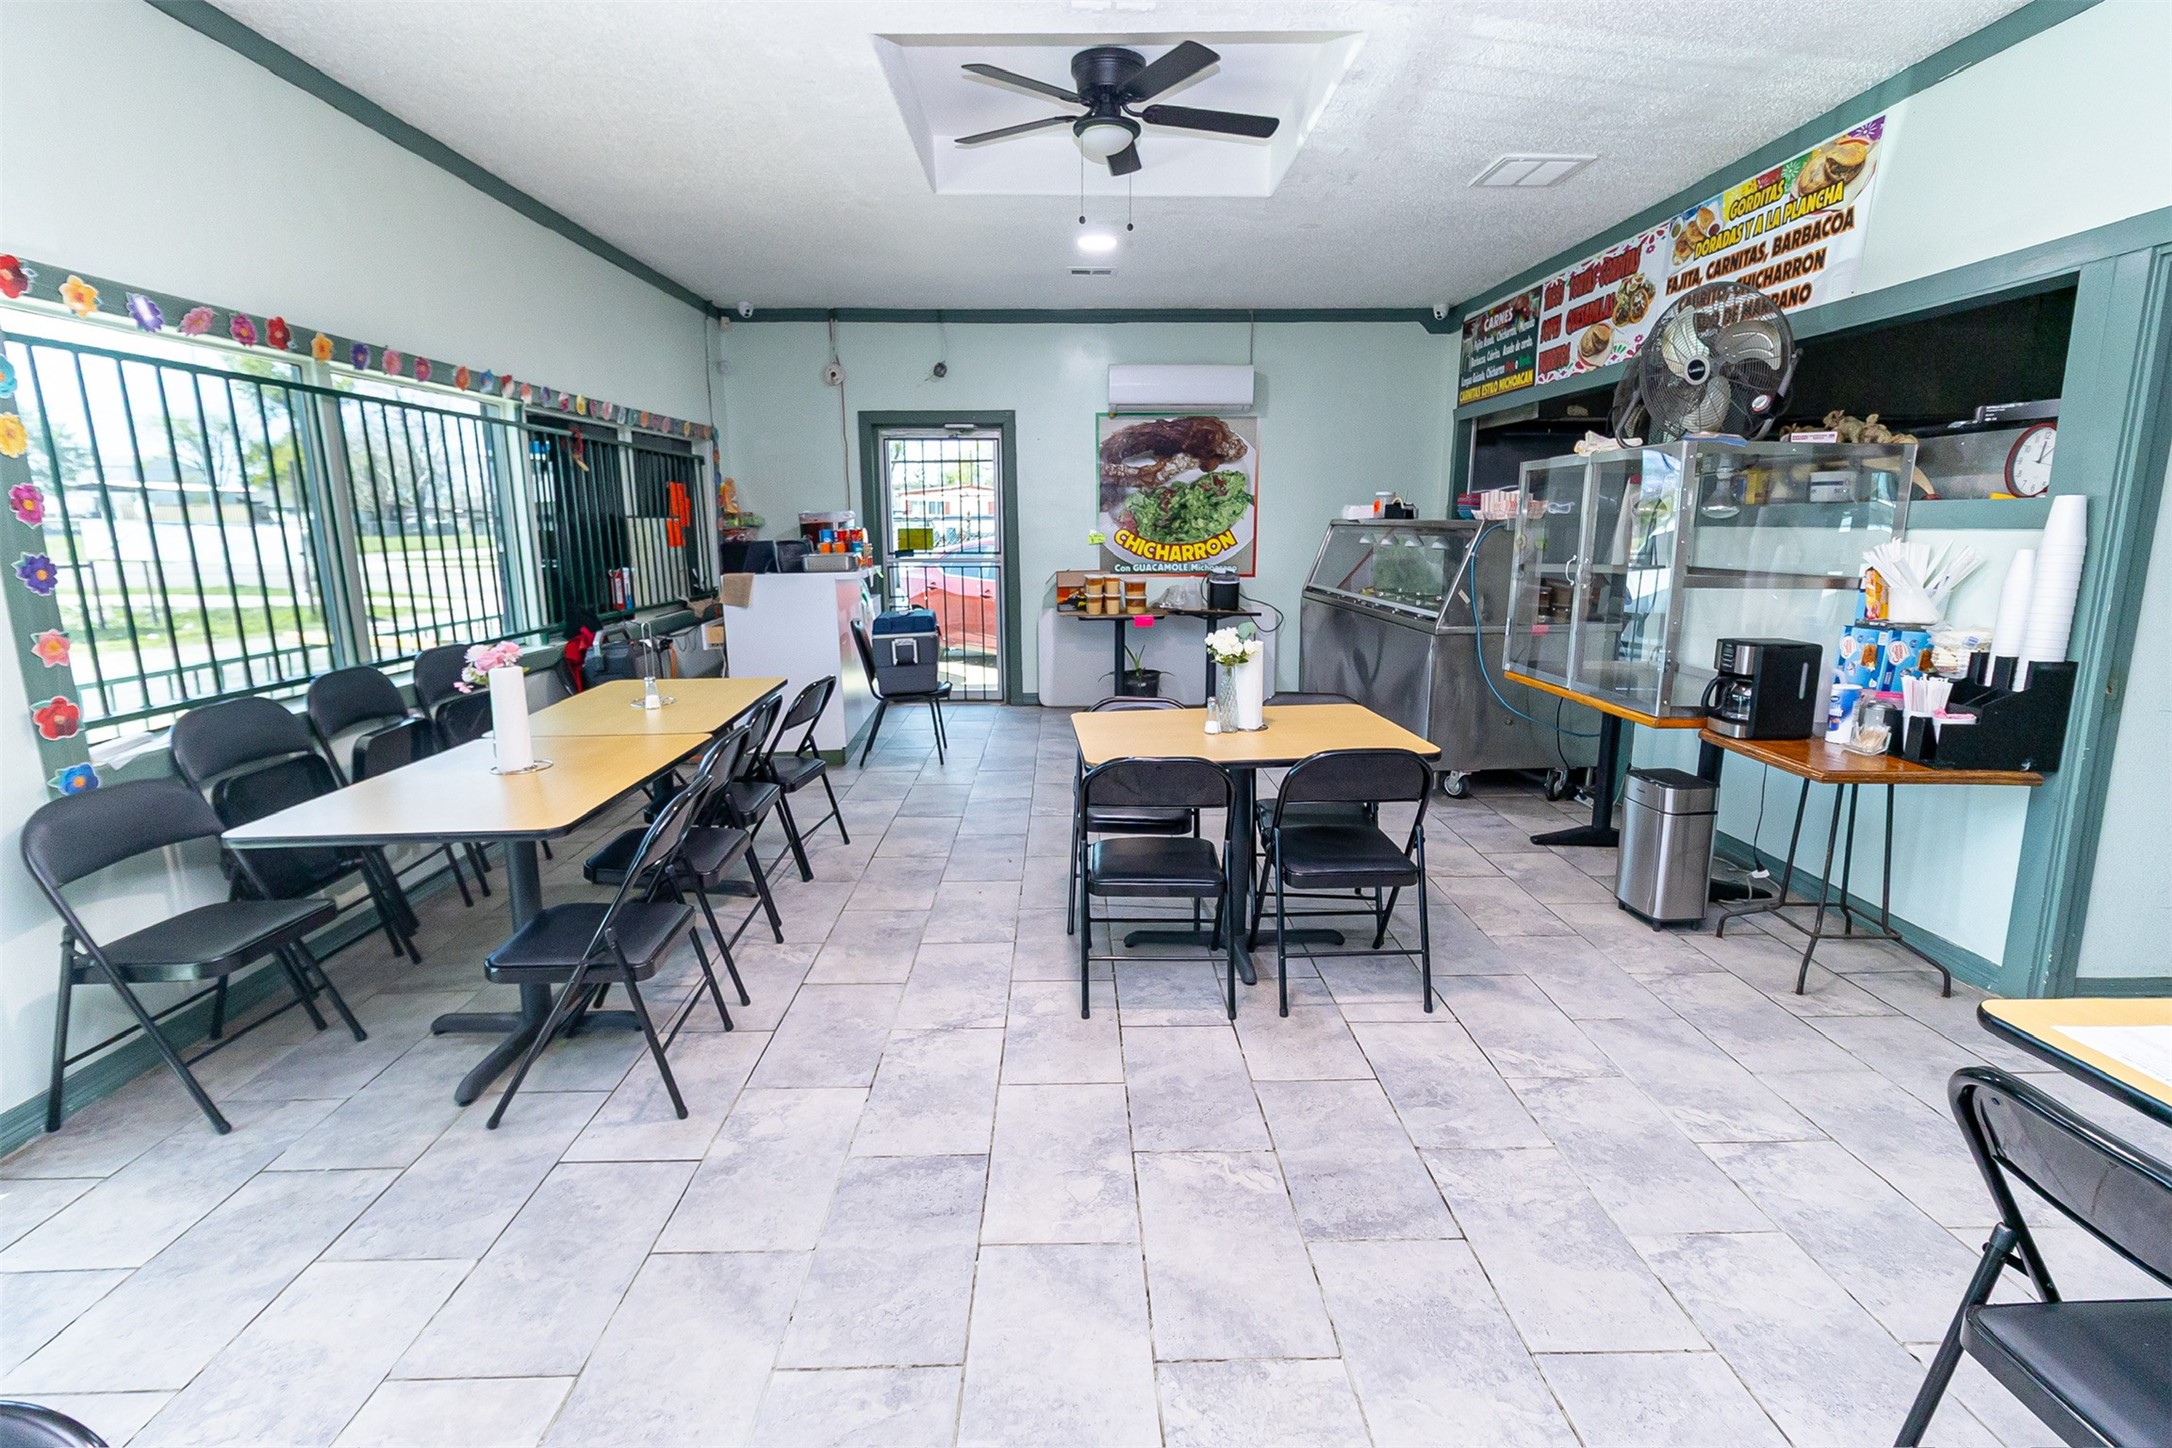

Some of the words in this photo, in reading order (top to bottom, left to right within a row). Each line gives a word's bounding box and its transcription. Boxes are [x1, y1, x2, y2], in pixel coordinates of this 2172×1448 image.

[1728, 177, 1786, 221] GORDITAS
[1693, 222, 1744, 260] DORADAS
[1745, 221, 1756, 240] Y
[1754, 215, 1764, 236] A
[1764, 209, 1782, 233] LA
[1782, 179, 1845, 226] PLANCHA
[1665, 266, 1703, 297] FAJITA,
[1705, 242, 1769, 281] CARNITAS,
[1771, 204, 1856, 259] BARBACOA
[1484, 307, 1514, 332] CARNES
[1481, 380, 1499, 397] ESTILO
[1498, 370, 1534, 392] MICHOACAN
[1114, 528, 1239, 563] CHICHARRON
[1114, 563, 1131, 573] Con
[1132, 563, 1189, 573] GUACAMOLE
